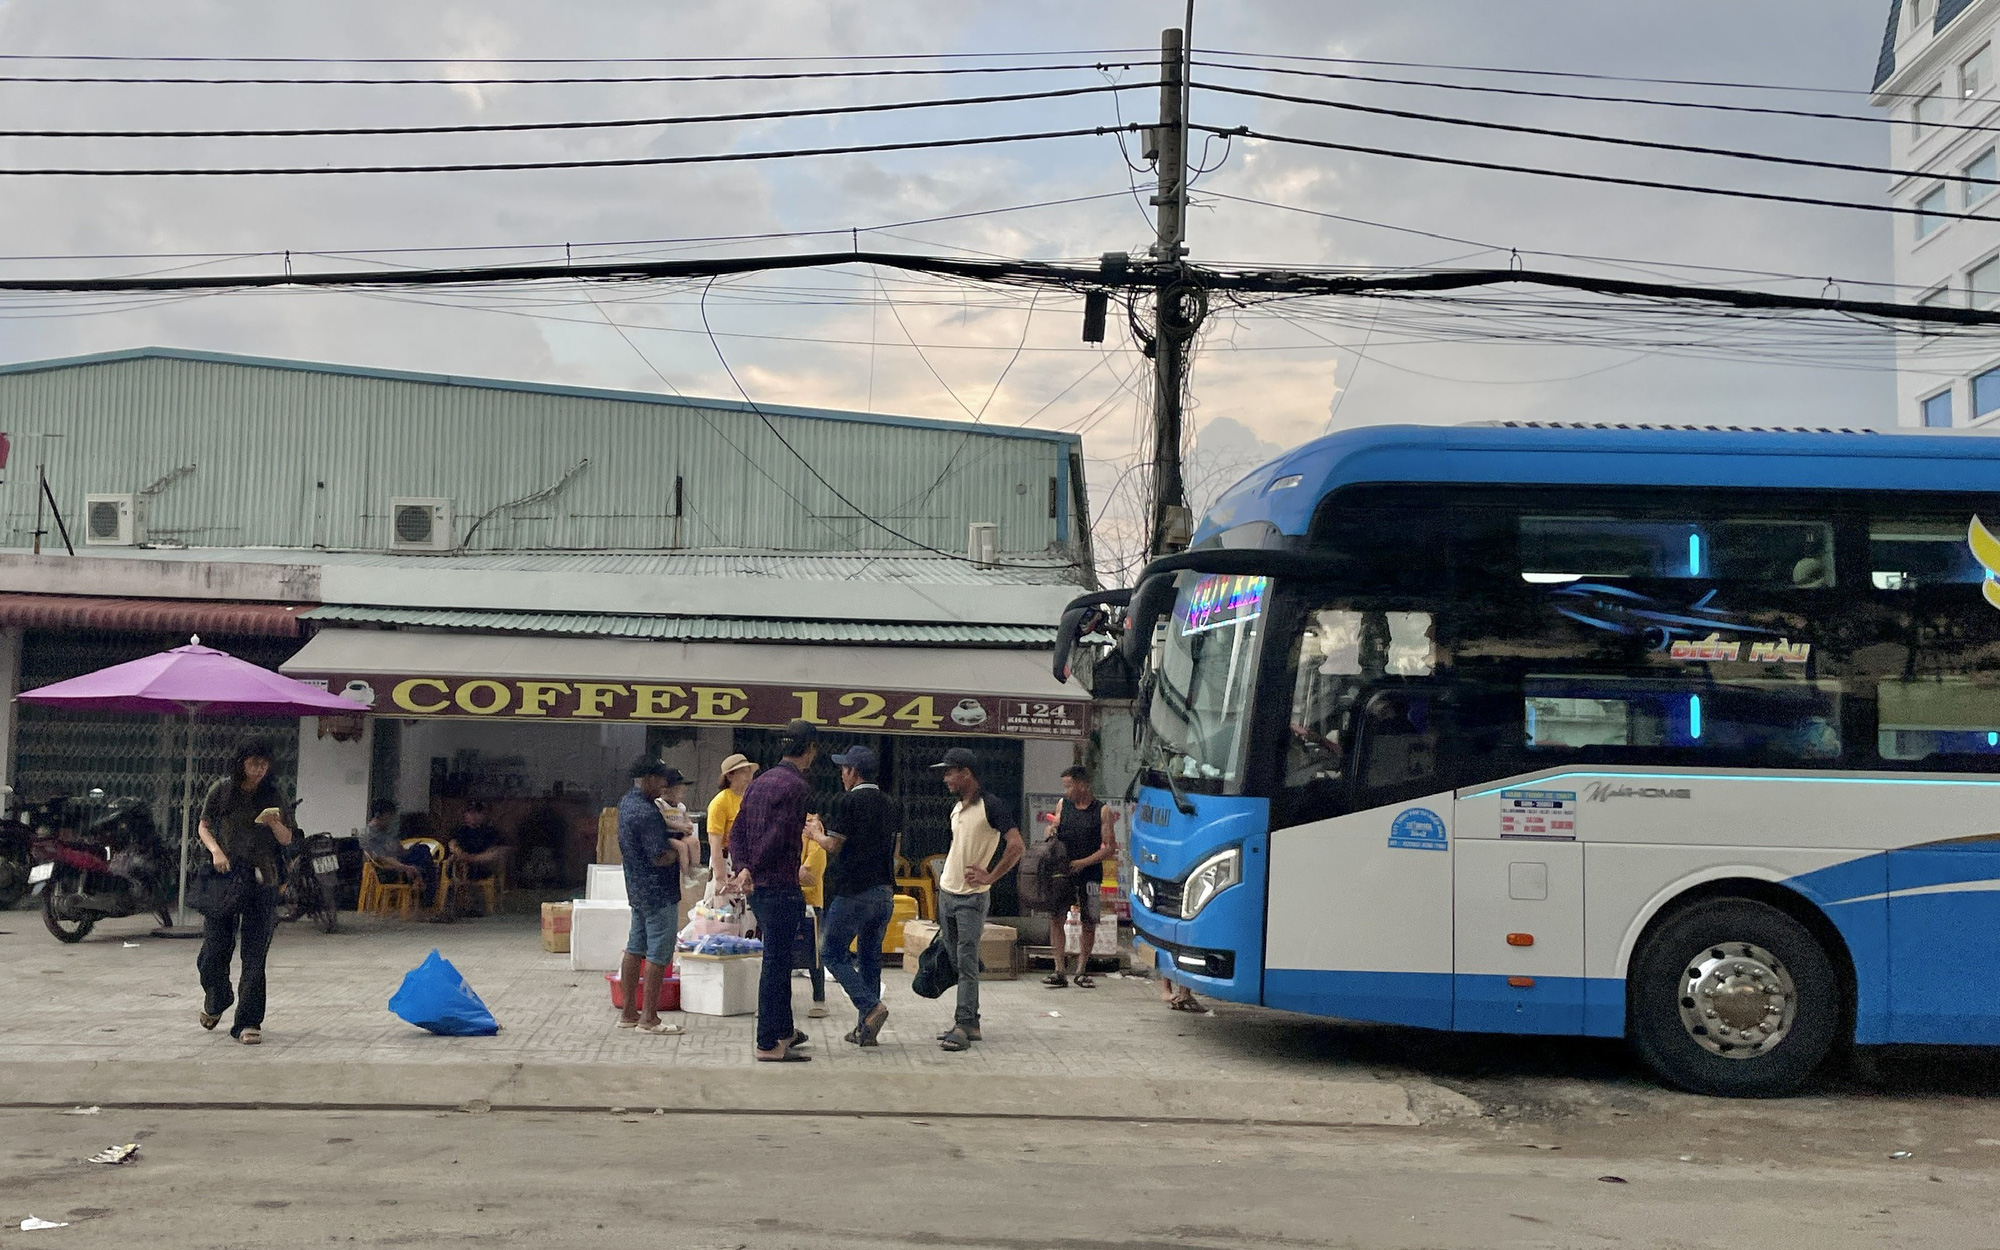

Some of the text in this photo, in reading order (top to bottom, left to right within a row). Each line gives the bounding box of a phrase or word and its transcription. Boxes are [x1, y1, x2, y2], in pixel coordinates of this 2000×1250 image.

[391, 678, 944, 729] COFFEE 124
[1016, 702, 1067, 718] 124
